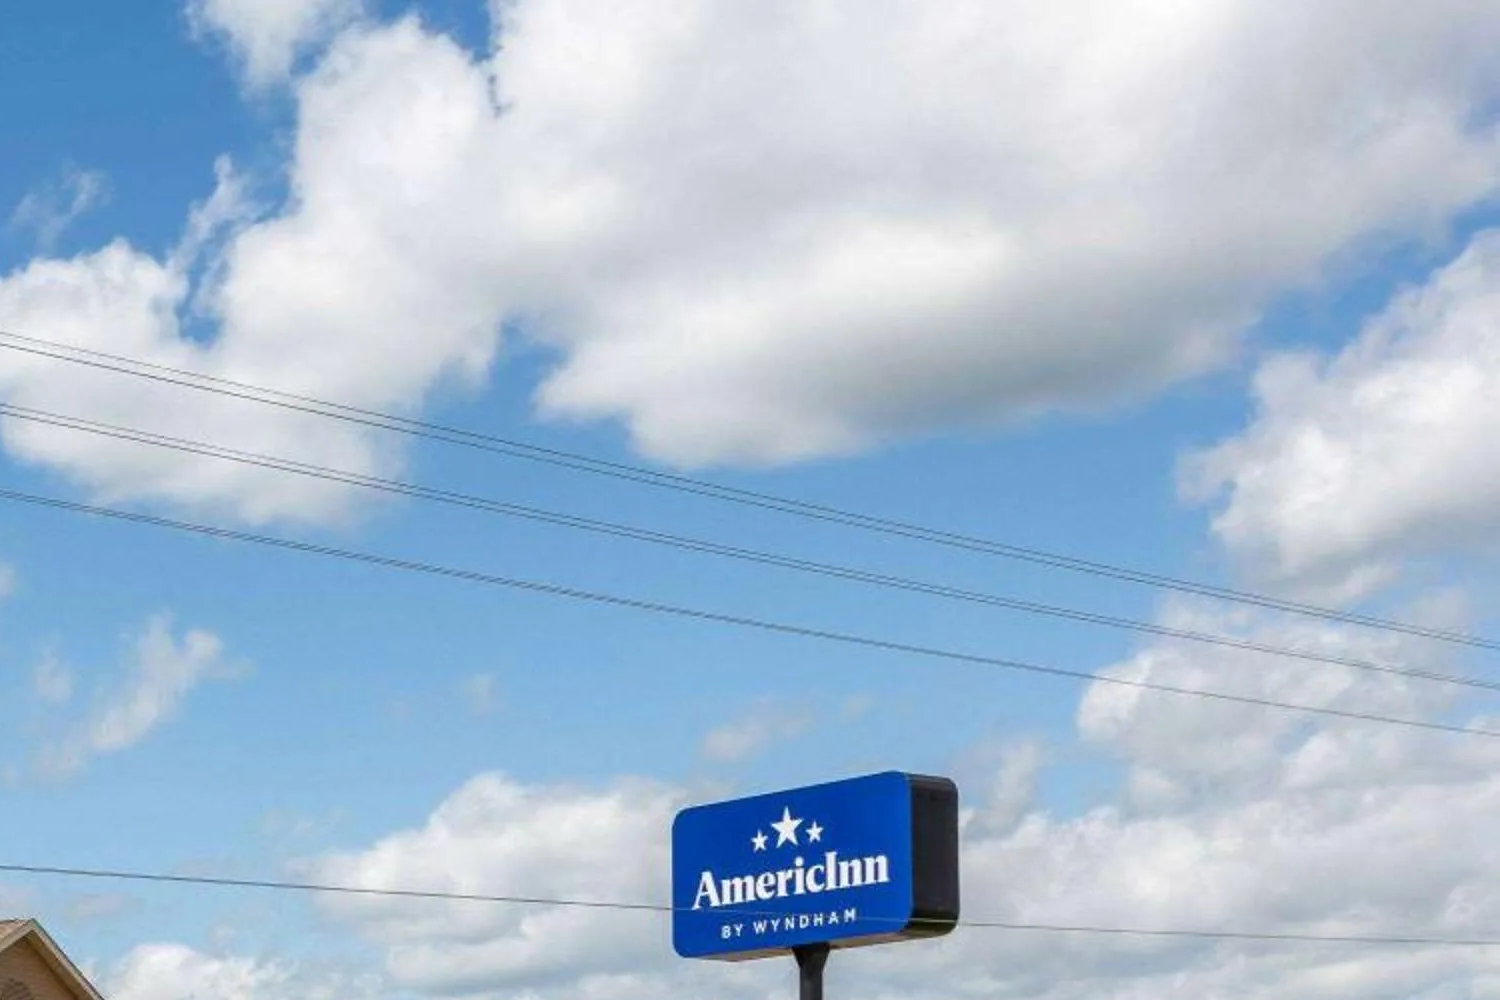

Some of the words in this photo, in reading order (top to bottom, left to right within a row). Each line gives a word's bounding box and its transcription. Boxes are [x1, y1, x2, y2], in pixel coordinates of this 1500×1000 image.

[692, 851, 890, 911] AmericInn
[721, 922, 745, 940] BY
[753, 907, 857, 936] WYNDHAM
